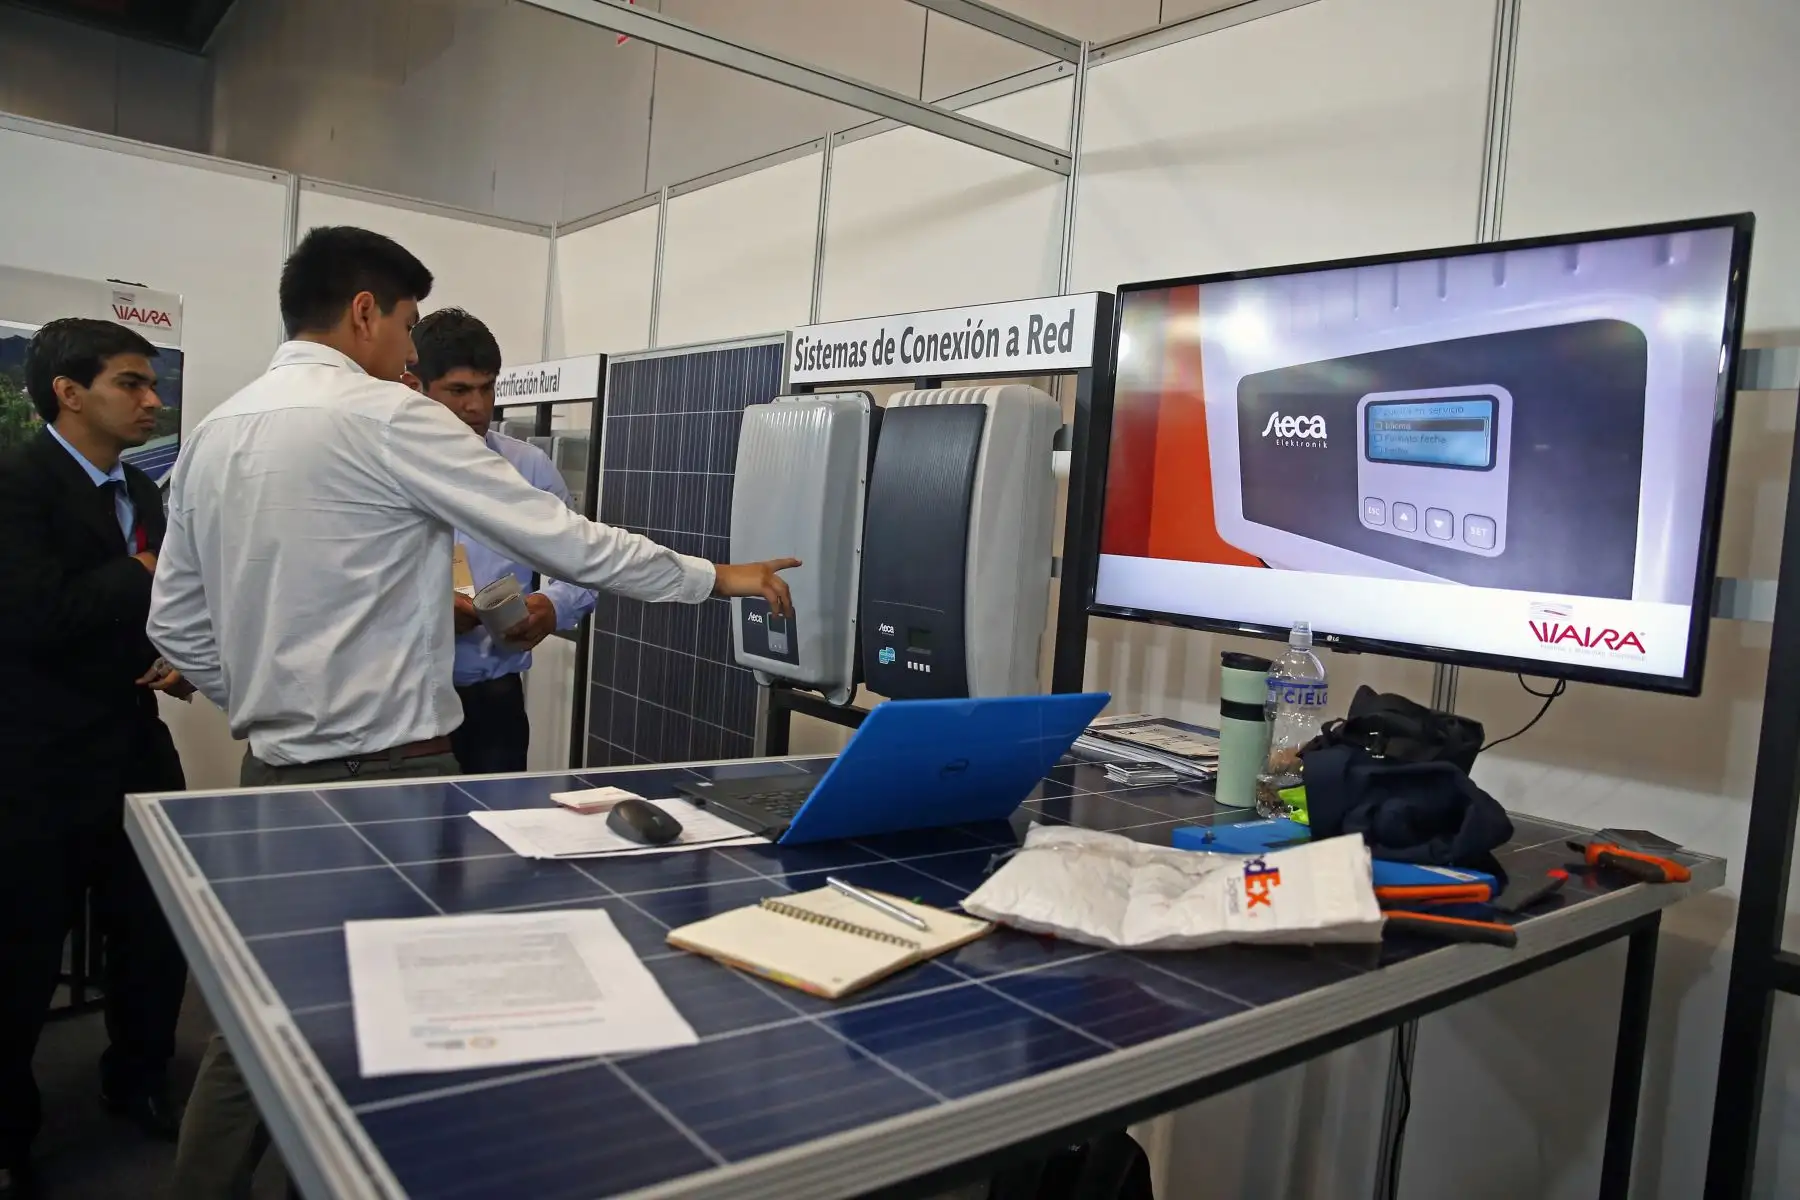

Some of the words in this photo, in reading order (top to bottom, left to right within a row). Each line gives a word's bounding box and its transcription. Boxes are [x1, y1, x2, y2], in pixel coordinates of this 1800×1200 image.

[112, 304, 172, 327] WAIRA
[794, 336, 867, 372] Sistemas
[872, 328, 896, 366] de
[900, 318, 1000, 365] Conexión
[1006, 324, 1020, 357] a
[1027, 308, 1076, 356] Red
[496, 371, 538, 398] ectrificación
[540, 367, 561, 394] Rural
[1276, 439, 1328, 449] Elektronik
[1470, 526, 1488, 537] SET
[1528, 620, 1646, 654] WAIRA
[1244, 858, 1281, 909] dEx
